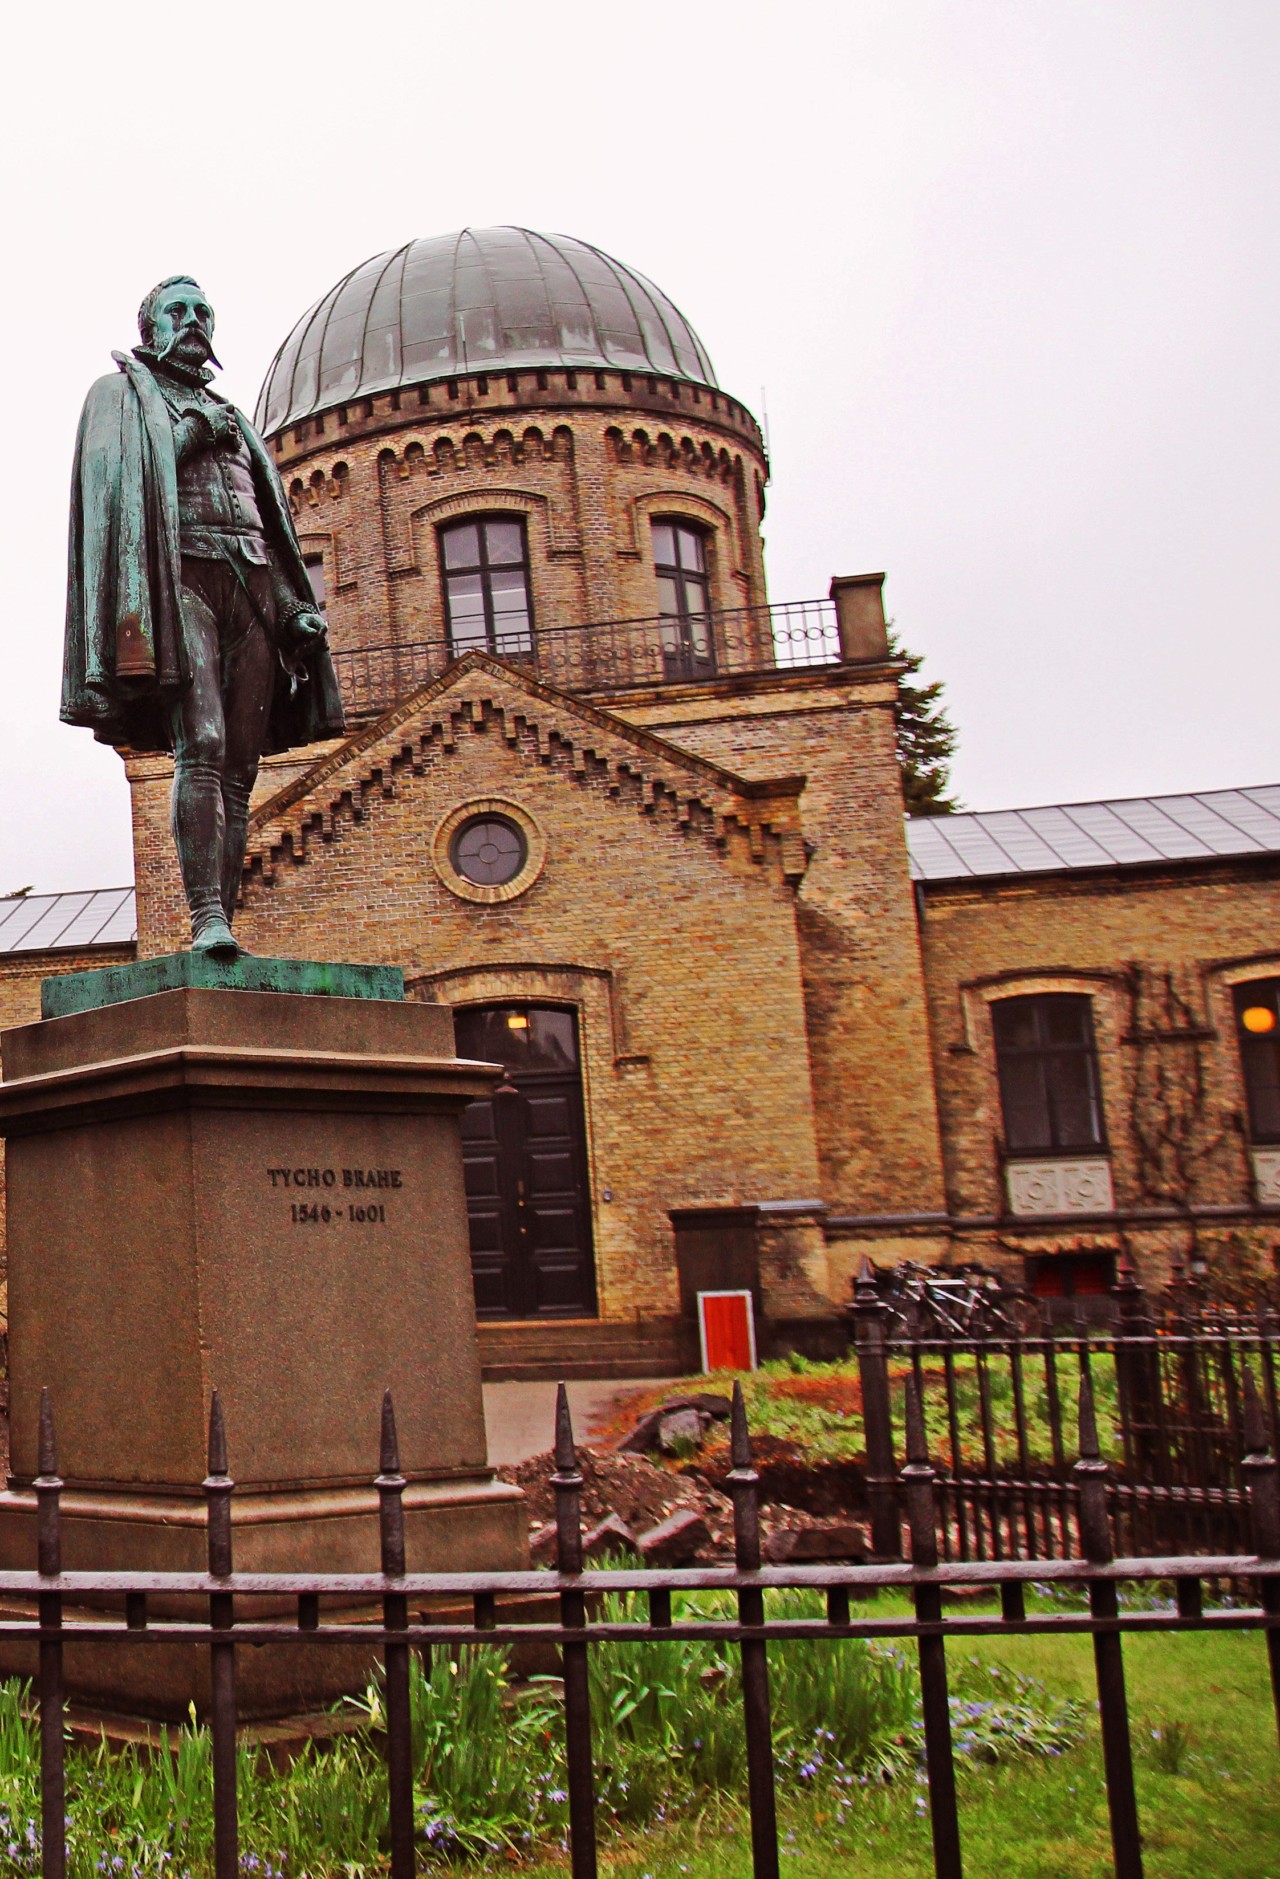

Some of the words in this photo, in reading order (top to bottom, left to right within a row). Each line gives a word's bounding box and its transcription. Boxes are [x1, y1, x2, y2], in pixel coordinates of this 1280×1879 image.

[267, 1168, 336, 1187] TYCHO
[342, 1169, 403, 1188] BRAHE
[291, 1204, 331, 1223] 1546
[349, 1205, 385, 1223] 1601
